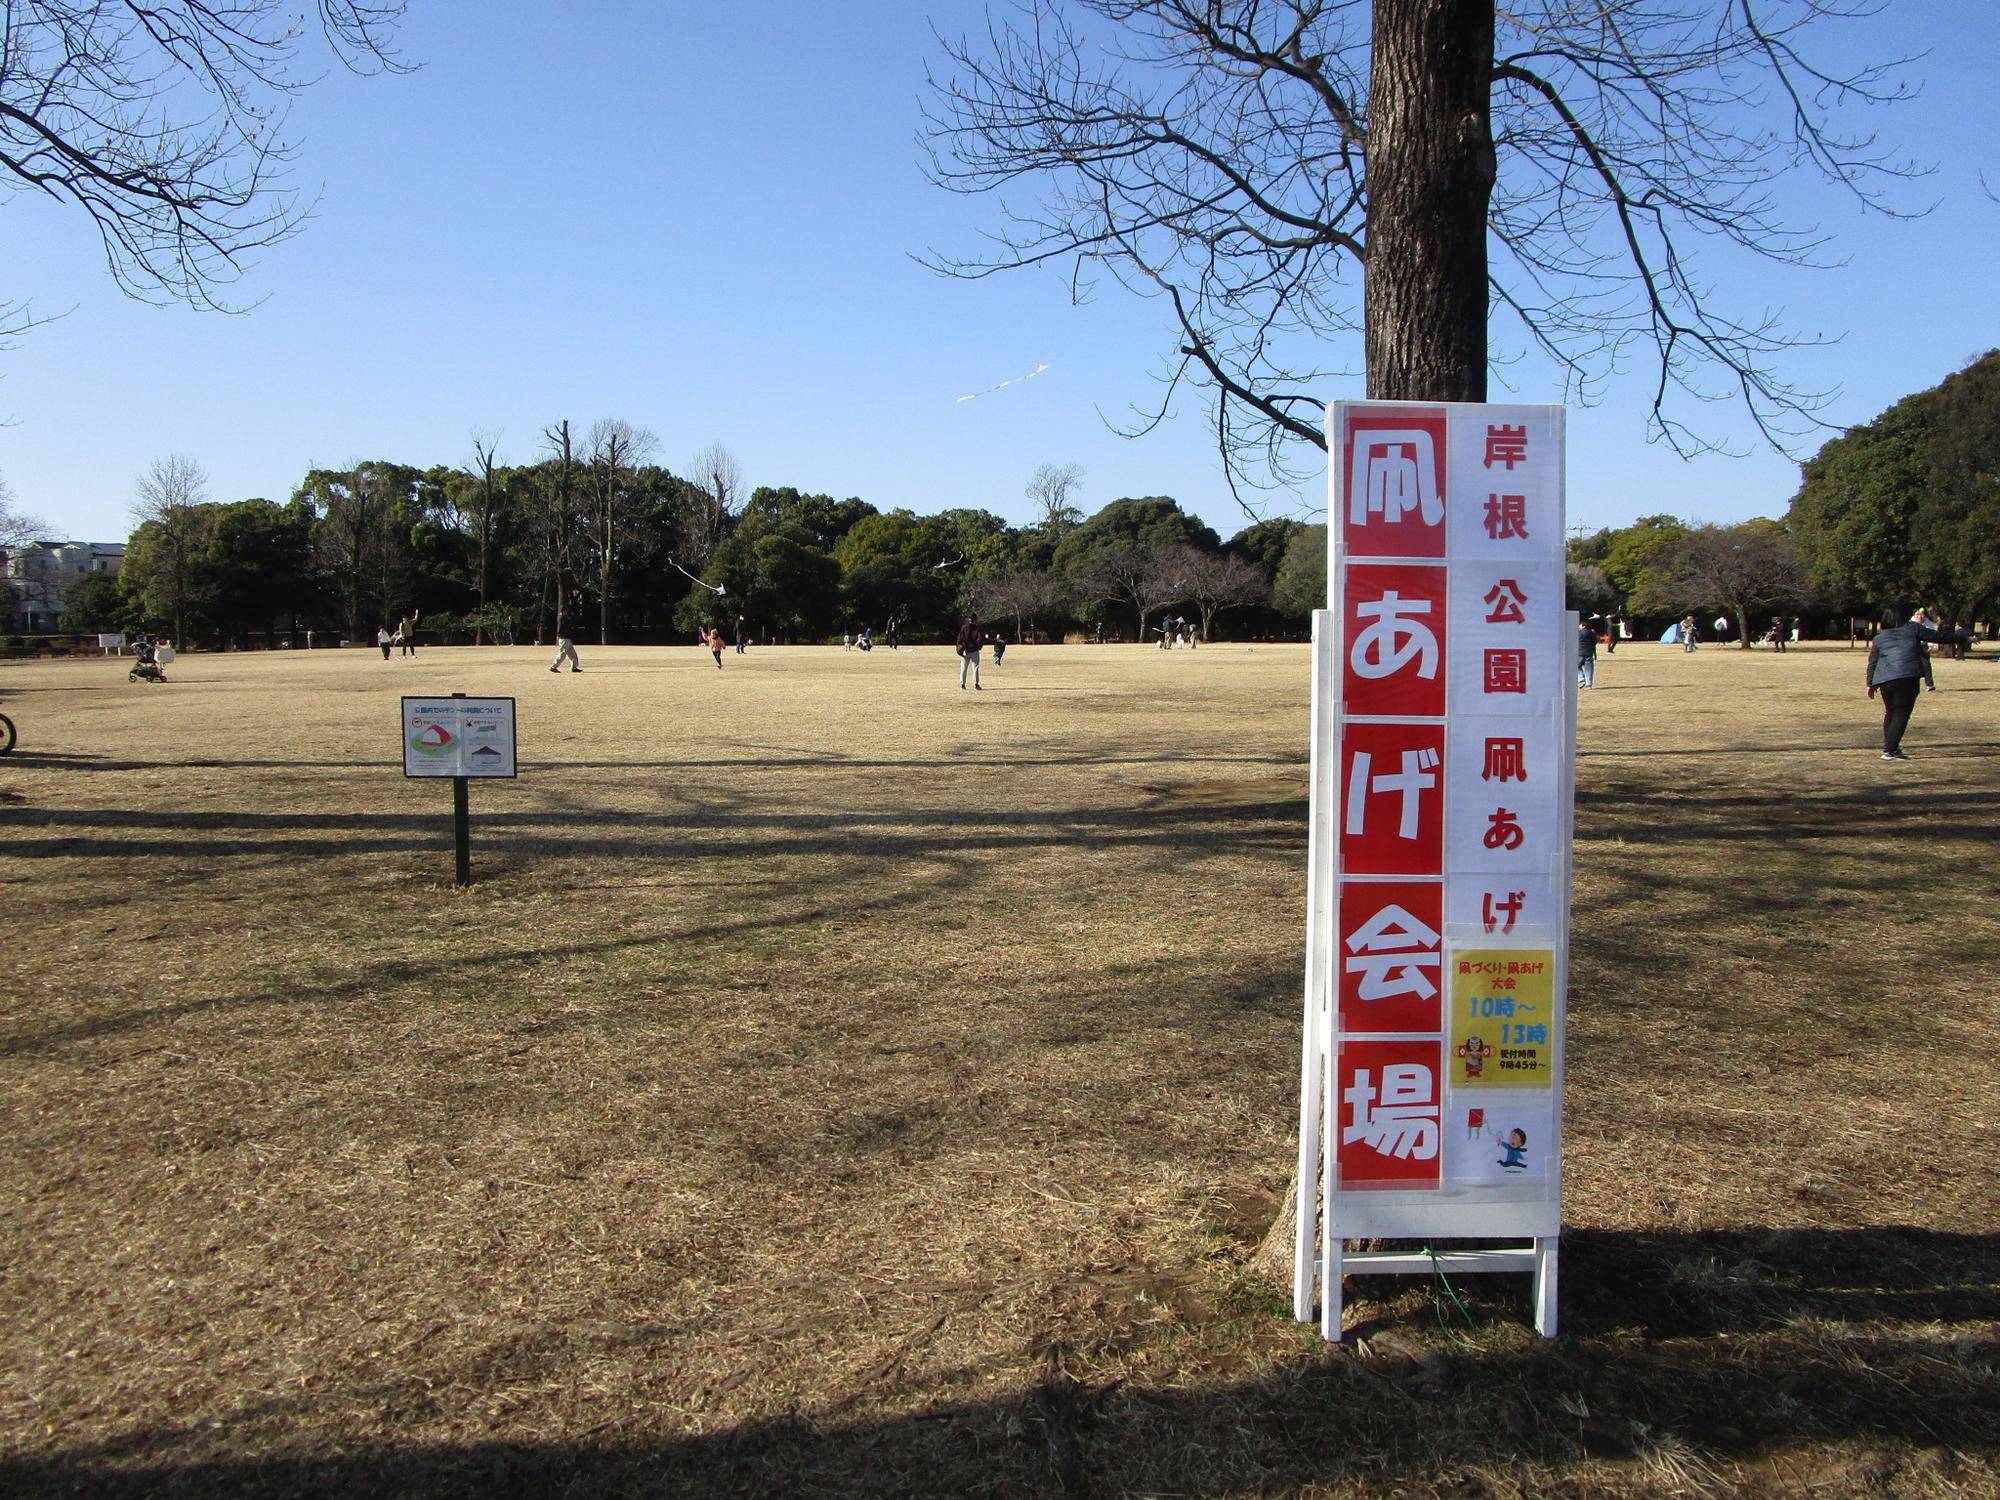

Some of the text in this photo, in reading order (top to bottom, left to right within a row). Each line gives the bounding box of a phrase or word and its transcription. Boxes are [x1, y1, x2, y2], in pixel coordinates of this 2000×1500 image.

[1482, 424, 1529, 934] 岸根公園凧あげ
[1343, 429, 1445, 1160] 凧あげ会場
[1491, 977, 1517, 990] 大会
[1502, 1023, 1548, 1046] 13時
[1500, 1049, 1537, 1059] 受付時間
